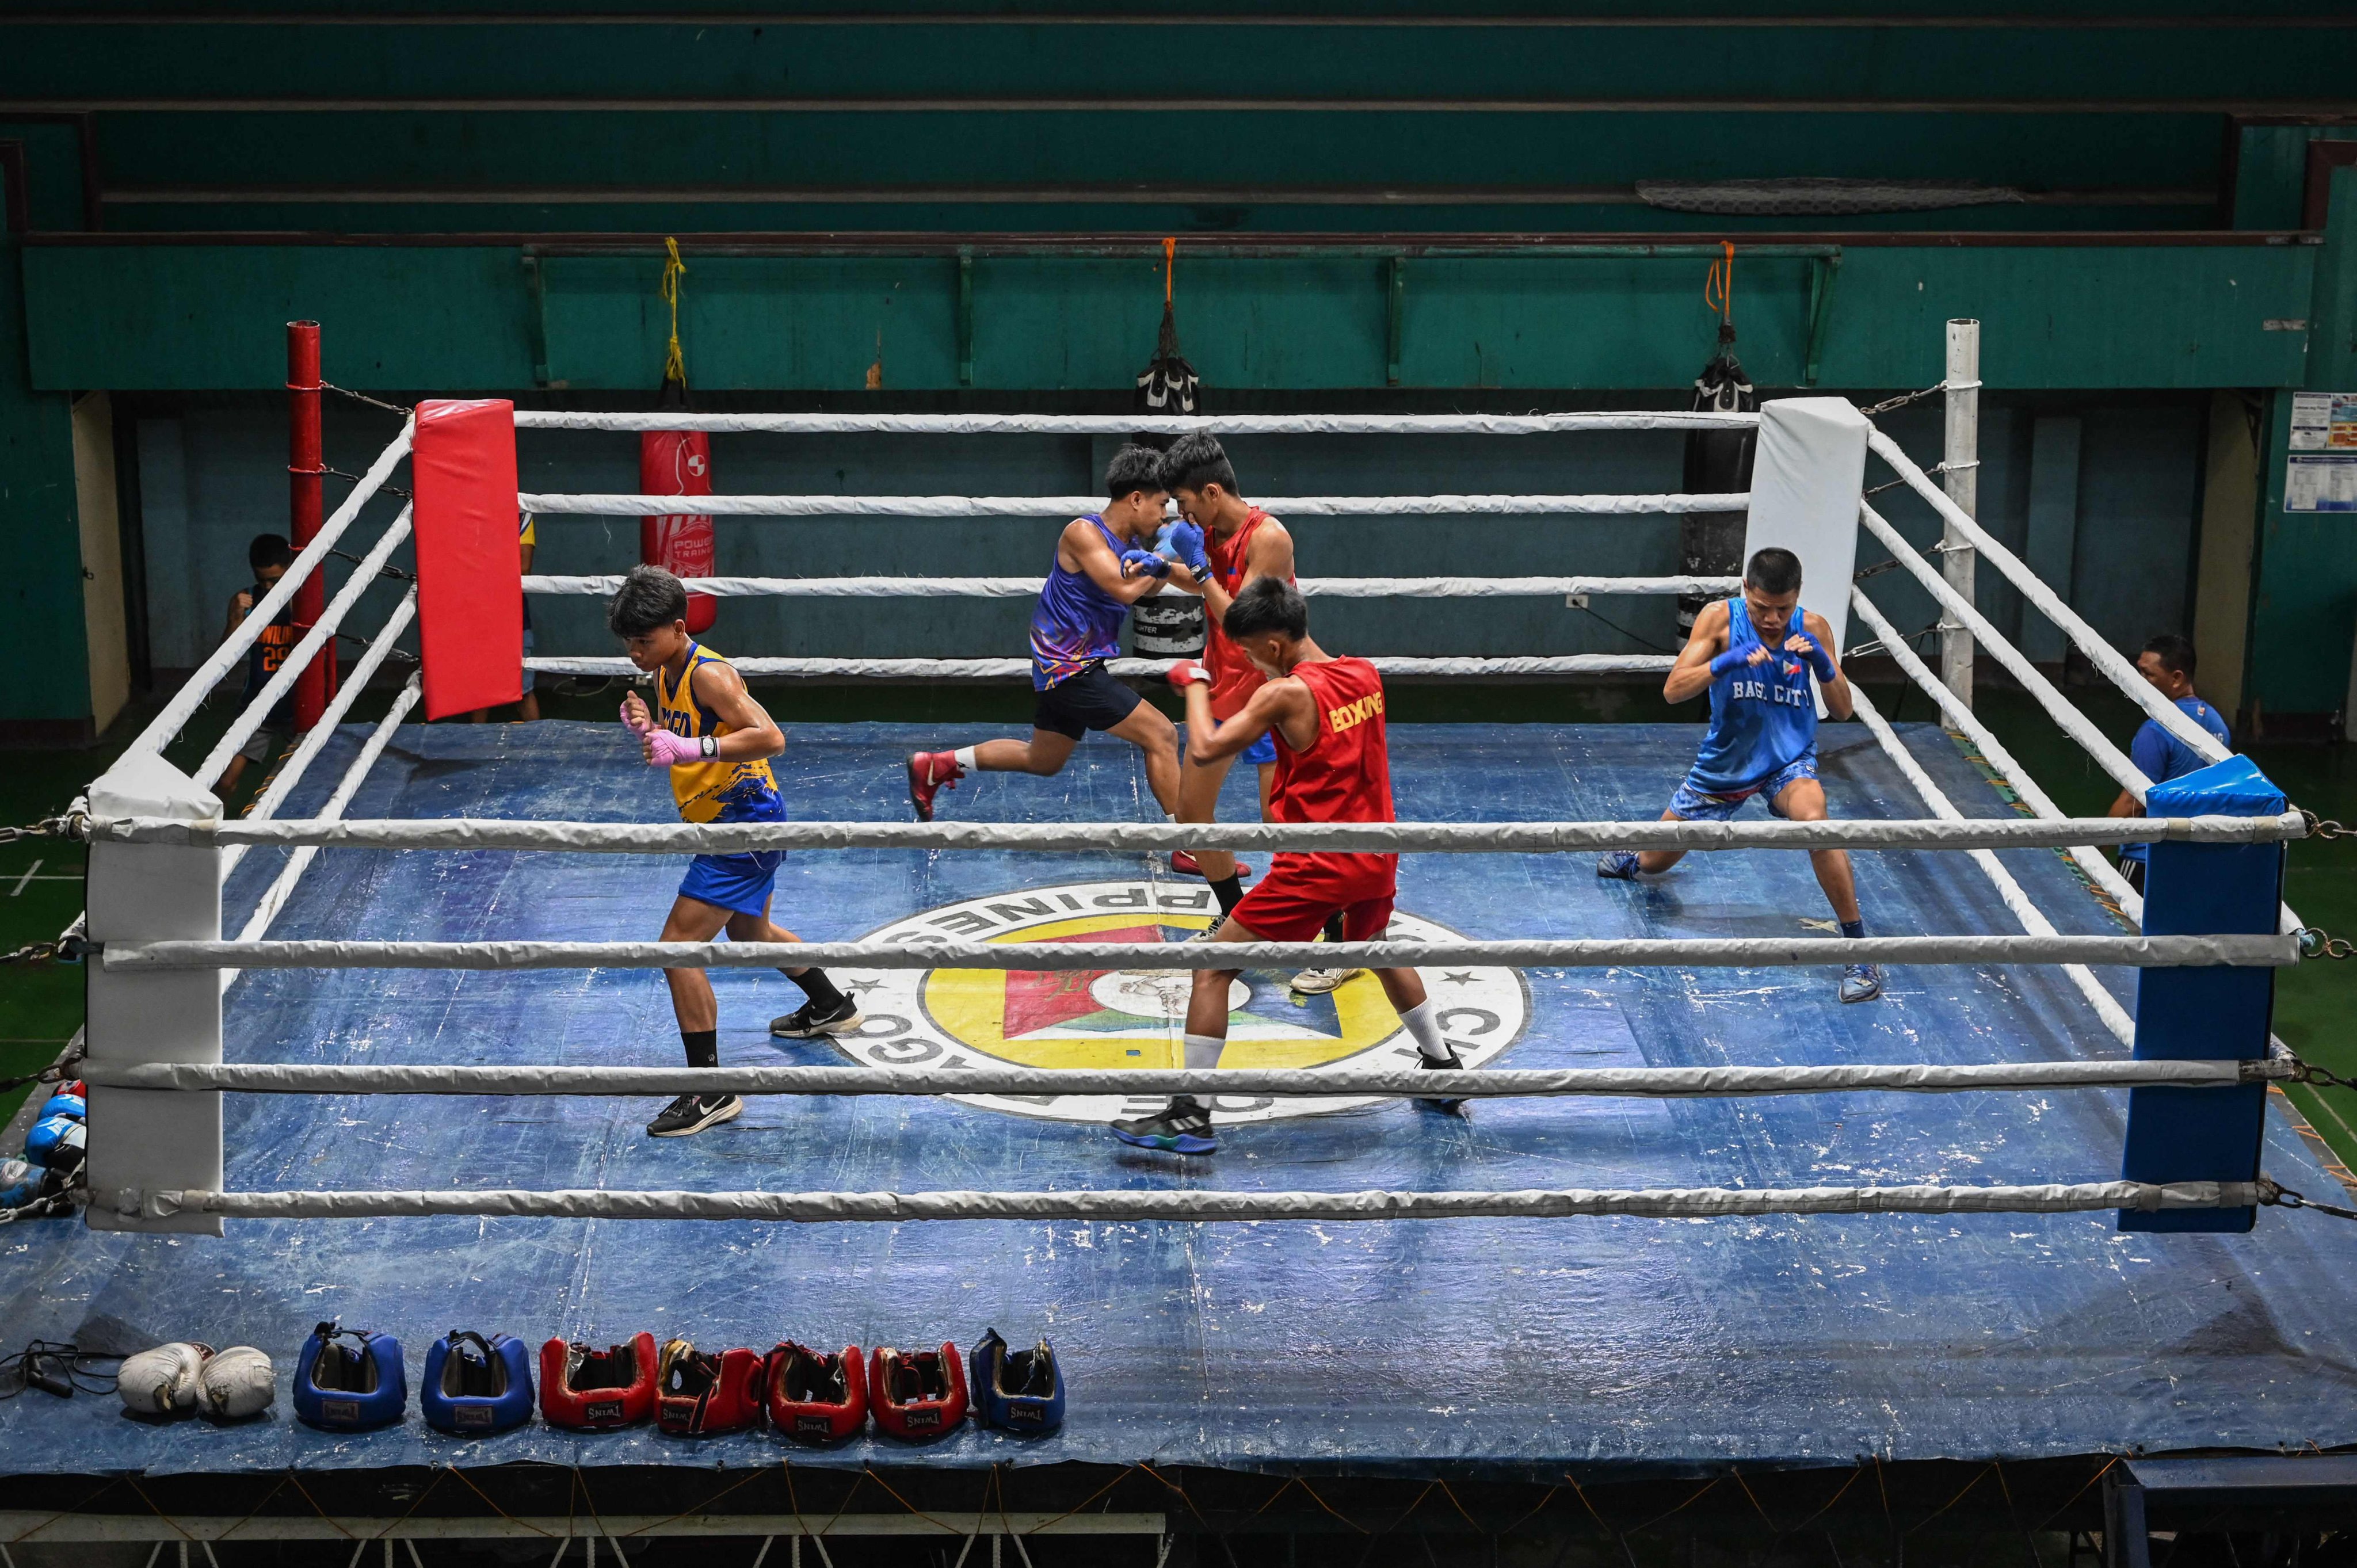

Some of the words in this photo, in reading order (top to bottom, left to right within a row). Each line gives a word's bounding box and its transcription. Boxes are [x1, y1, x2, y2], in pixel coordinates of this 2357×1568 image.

[1733, 681, 1767, 701] BAG
[1329, 691, 1383, 733] BOXING
[588, 1405, 621, 1420] TWINS
[1010, 1407, 1042, 1421] TWINS
[798, 1420, 829, 1433] TWINS
[907, 1413, 939, 1427] TWINS
